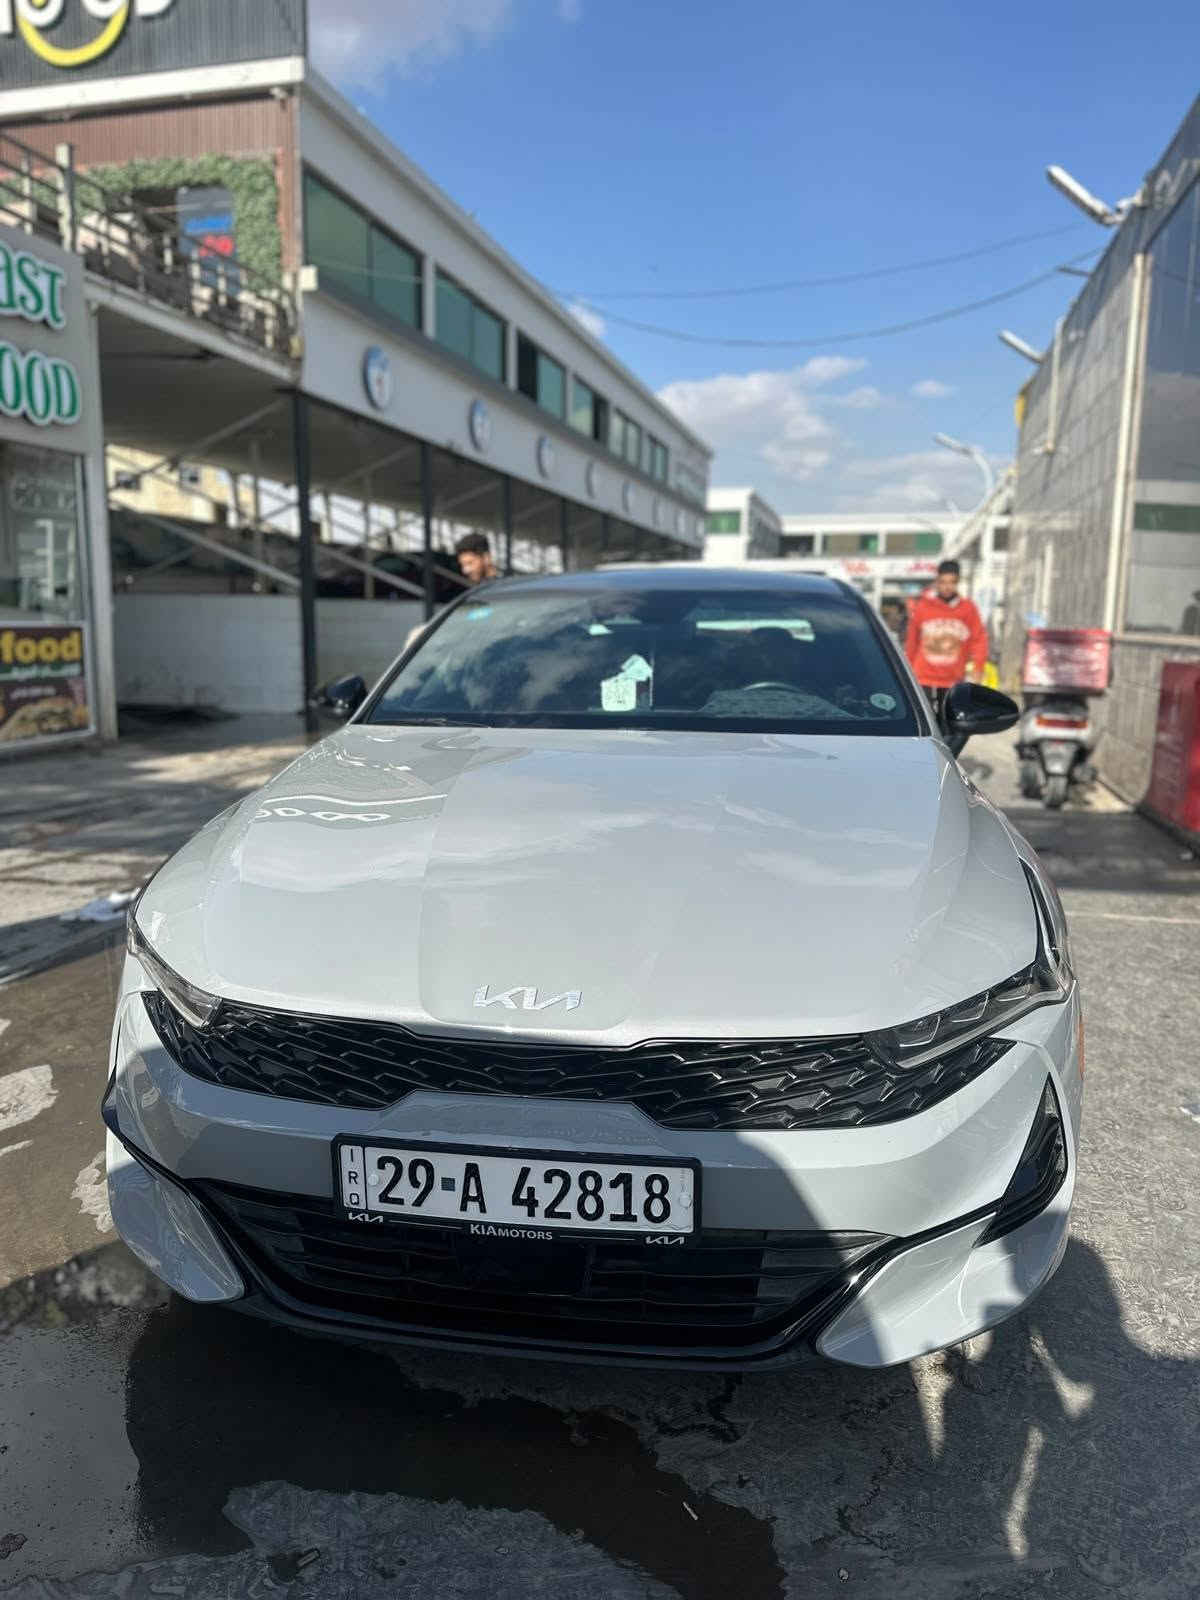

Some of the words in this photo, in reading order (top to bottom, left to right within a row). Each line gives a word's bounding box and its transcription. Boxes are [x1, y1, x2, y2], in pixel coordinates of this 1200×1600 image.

[347, 1147, 361, 1206] IRQ
[376, 1154, 435, 1208] 29
[459, 1162, 487, 1214] A
[511, 1166, 671, 1225] 42818
